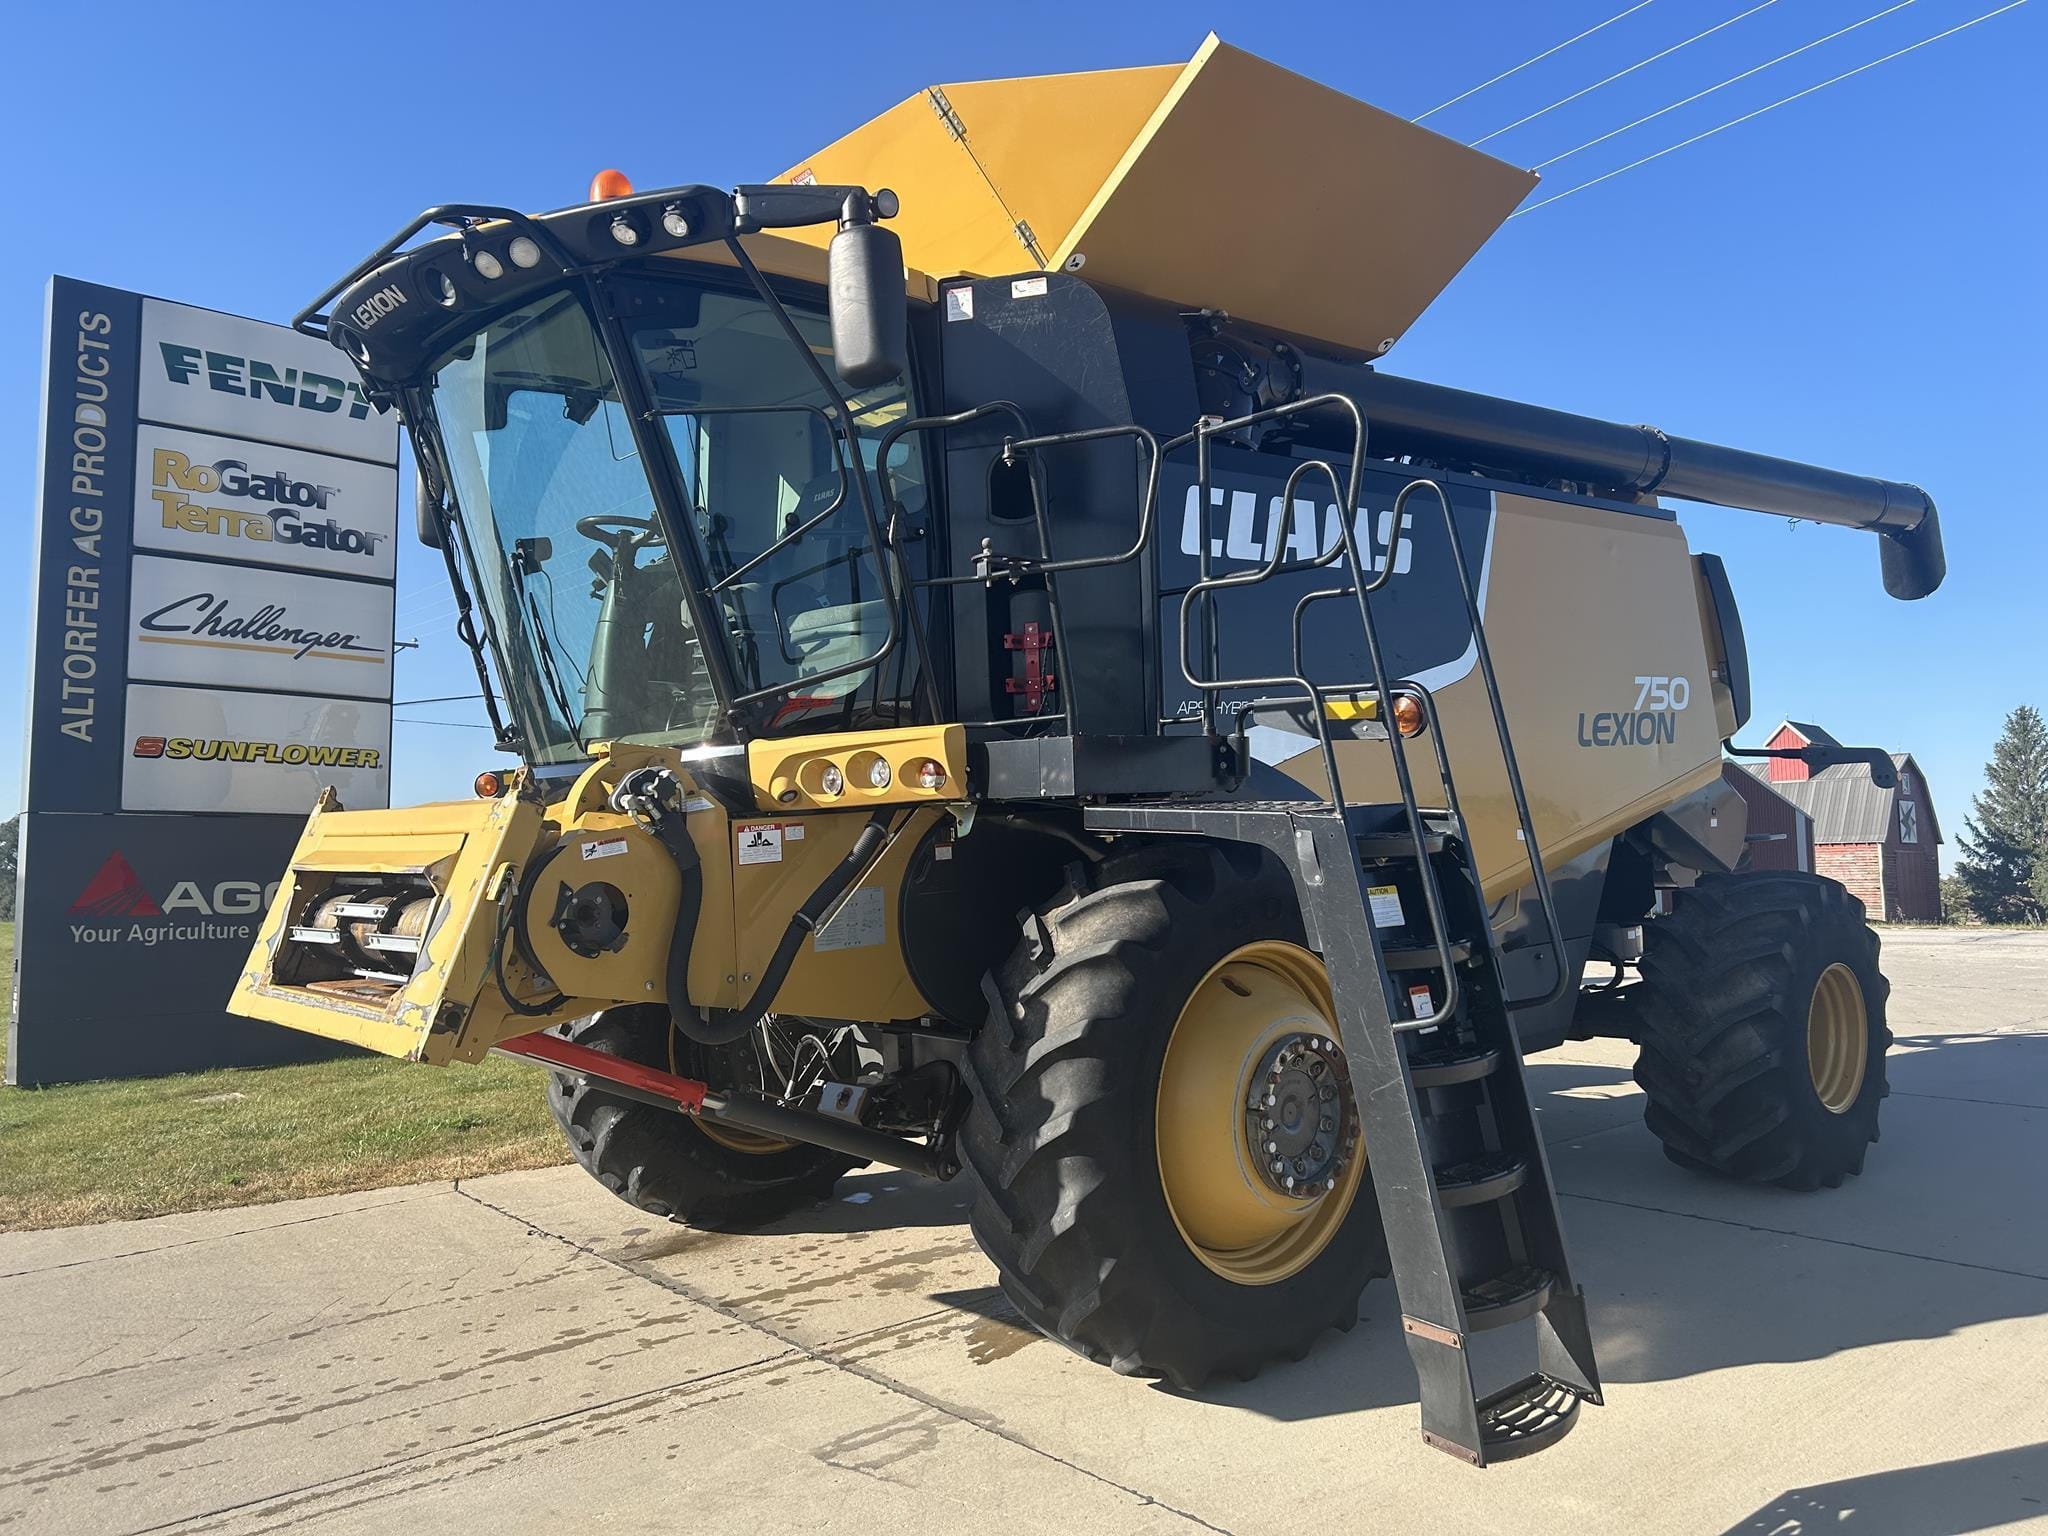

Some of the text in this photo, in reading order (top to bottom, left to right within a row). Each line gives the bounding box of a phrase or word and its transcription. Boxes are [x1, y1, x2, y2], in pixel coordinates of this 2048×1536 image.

[350, 284, 408, 330] LEXION
[159, 341, 370, 420] FENDT
[152, 448, 337, 510] RoGator
[60, 311, 112, 743] ALTORFER AG PRODUCTS
[152, 489, 384, 557] TerraGator
[1180, 485, 1413, 575] CLAAS
[139, 593, 385, 661] Challenger
[1633, 676, 1690, 711] 750
[1577, 711, 1676, 747] LEXION
[166, 738, 382, 769] SUNFLOWER
[751, 824, 775, 832] DANGER
[161, 881, 281, 915] AG
[70, 924, 122, 944] Your
[127, 921, 250, 946] Agriculture
